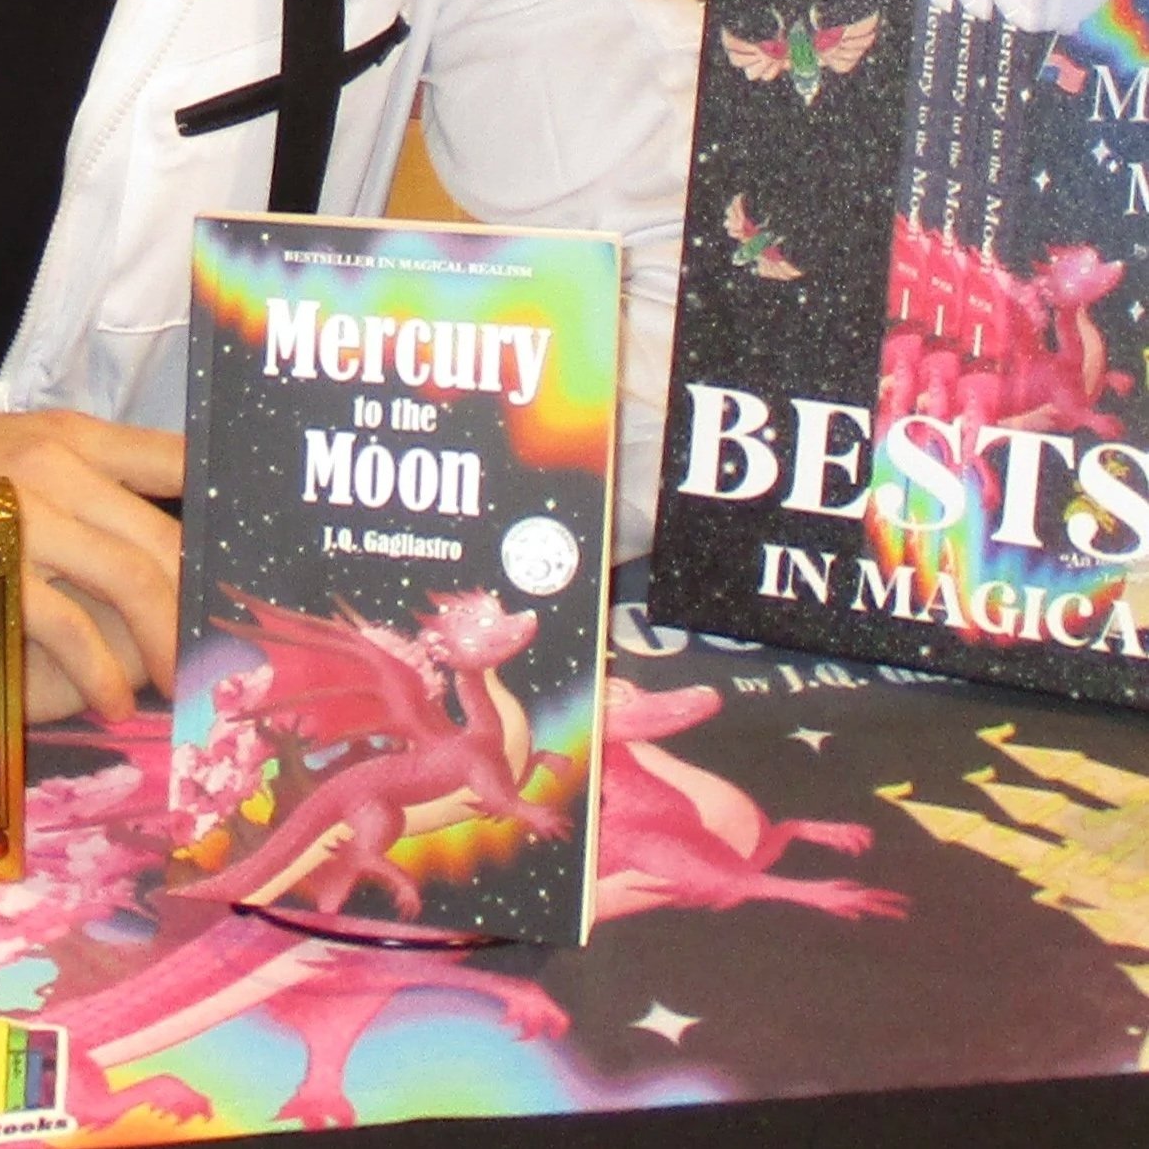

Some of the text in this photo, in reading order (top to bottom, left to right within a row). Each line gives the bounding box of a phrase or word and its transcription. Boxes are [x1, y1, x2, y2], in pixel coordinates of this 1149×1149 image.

[919, 5, 941, 98] ercury
[952, 11, 975, 107] ercury
[991, 21, 1016, 121] ercury
[918, 106, 929, 125] to
[952, 116, 963, 134] to
[915, 131, 927, 157] the
[949, 141, 961, 168] the
[992, 129, 1004, 148] to
[988, 156, 1001, 184] the
[283, 250, 532, 278] BESTSELLER IN MAGICAL REALISM
[263, 297, 551, 405] Mercury
[354, 395, 437, 432] to the
[302, 429, 481, 517] Moon
[324, 526, 463, 562] J.Q. Gagliastro
[758, 544, 837, 605] IN
